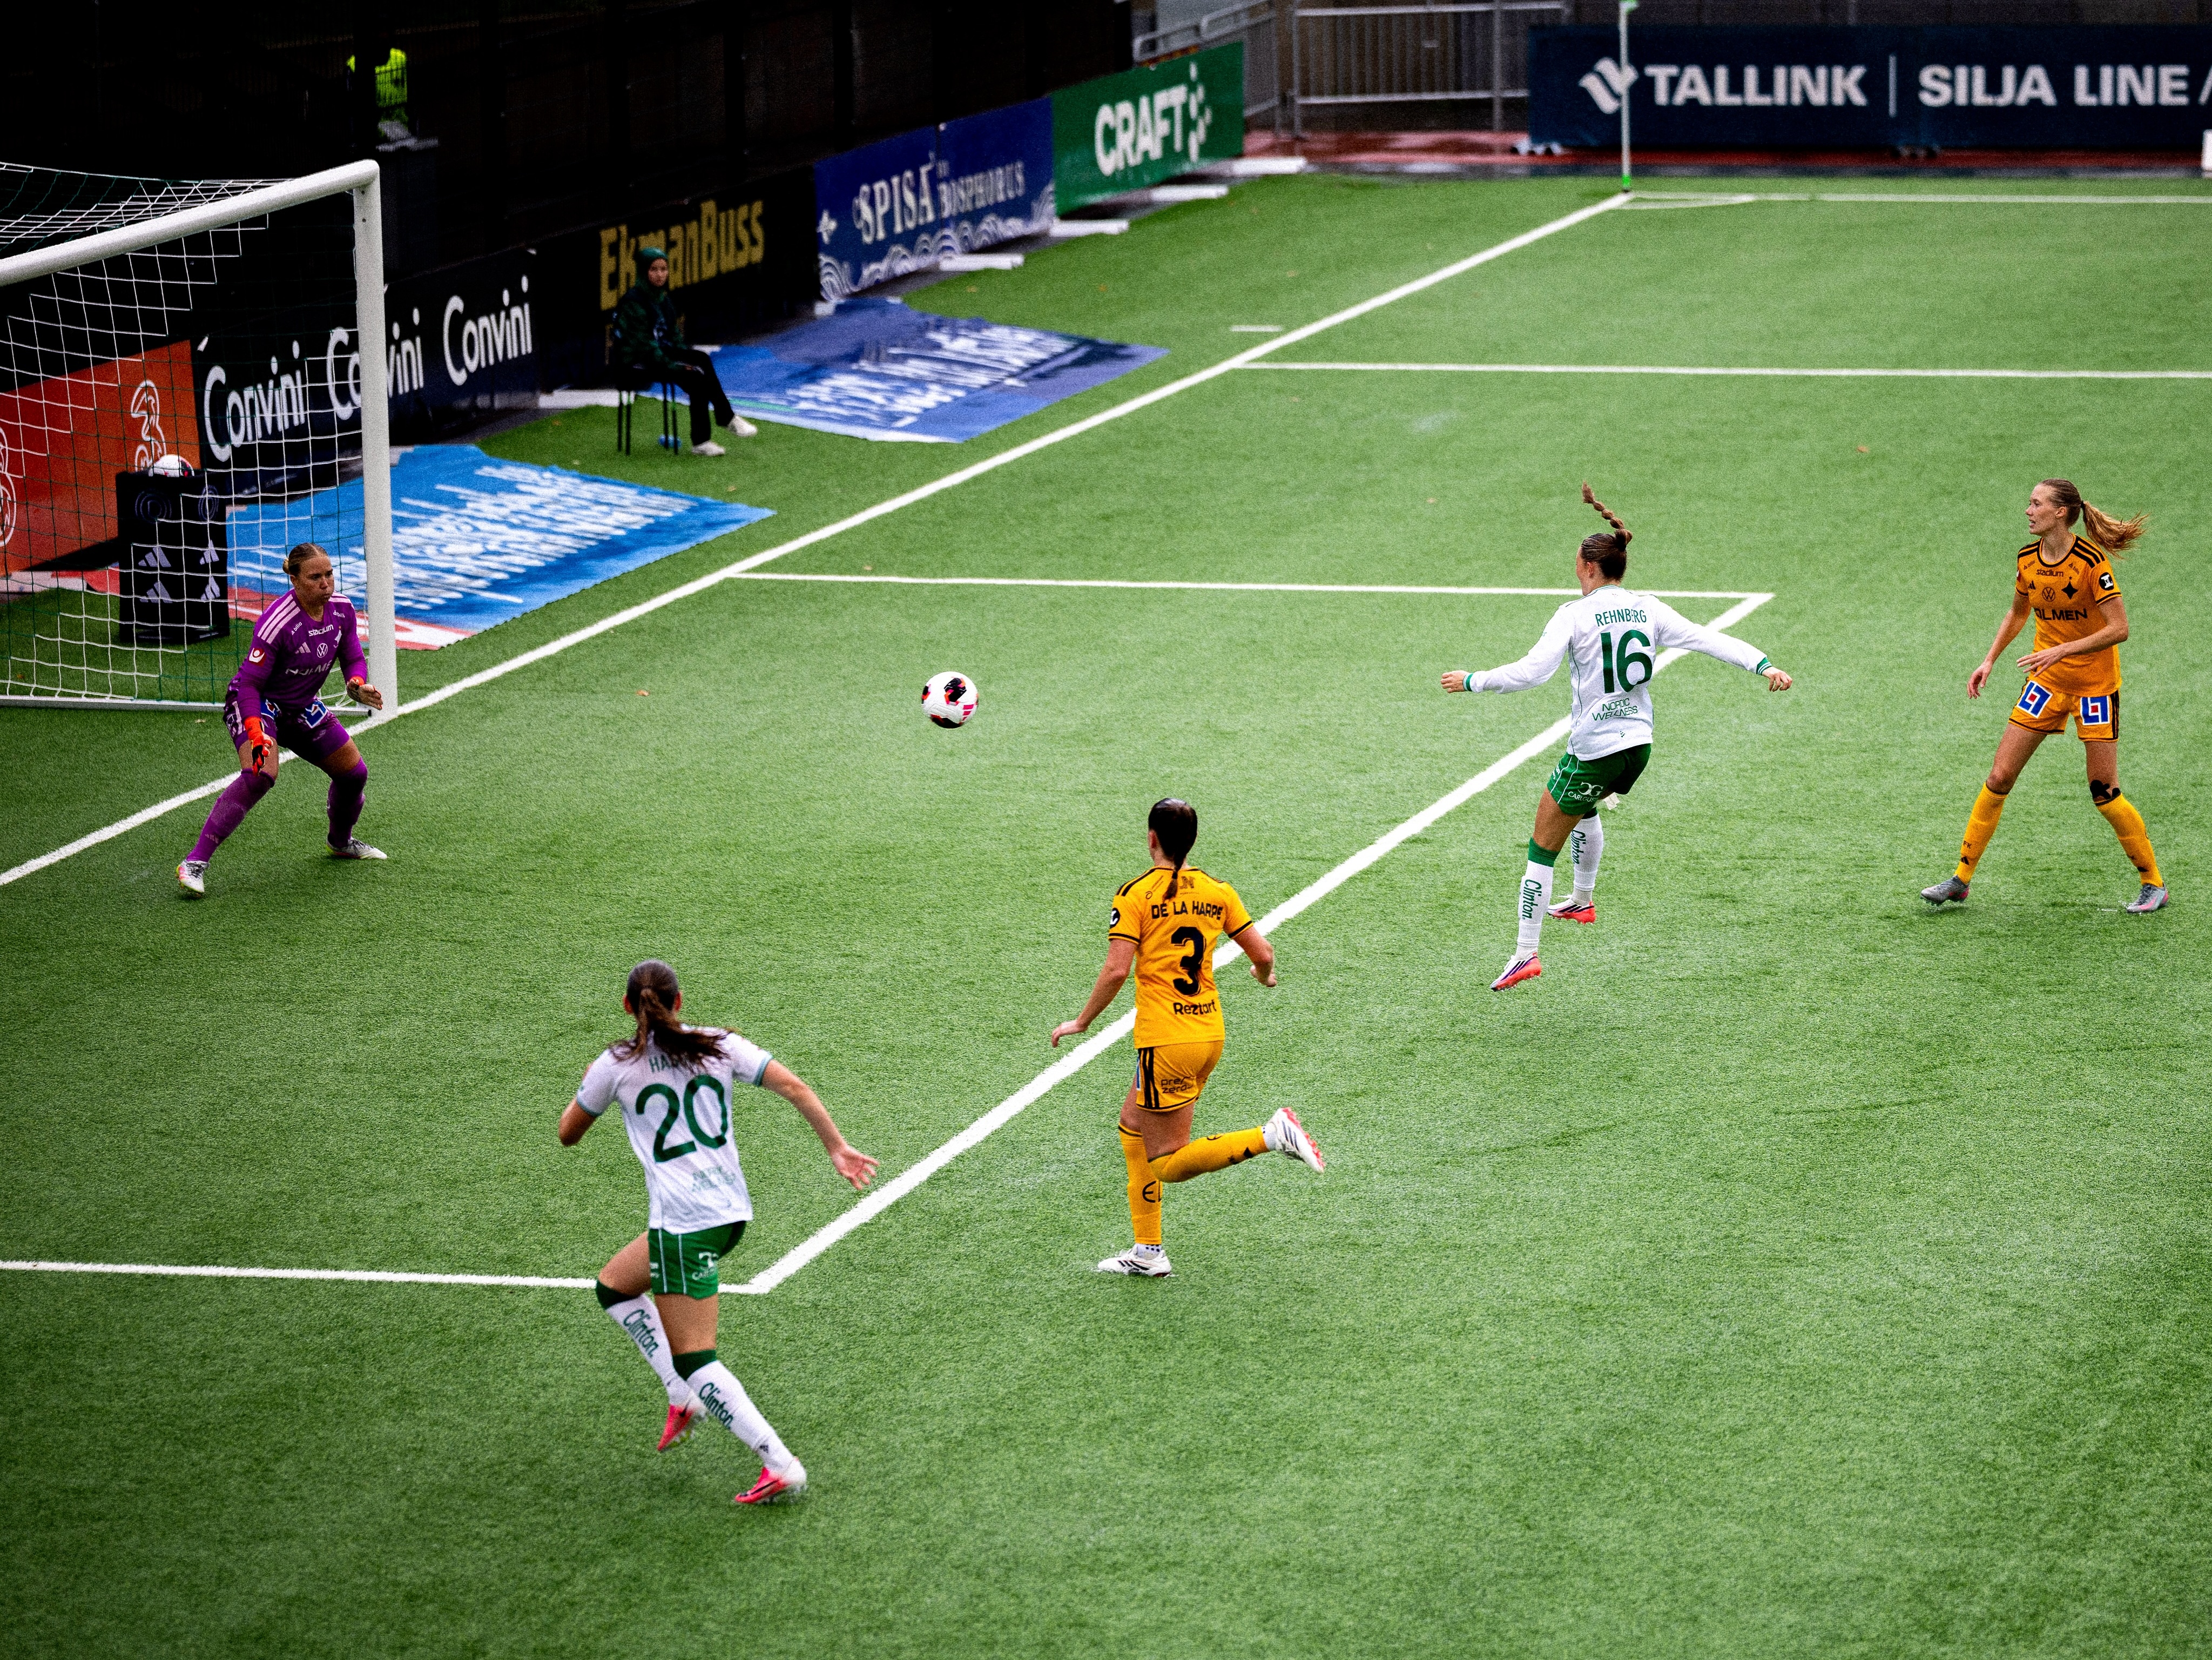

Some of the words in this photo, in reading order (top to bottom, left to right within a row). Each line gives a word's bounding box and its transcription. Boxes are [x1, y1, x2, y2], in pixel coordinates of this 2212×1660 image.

[1644, 64, 1867, 106] TALLINK
[1918, 64, 2058, 107] SILJA
[2074, 64, 2190, 106] LINE
[1095, 84, 1188, 176] CRAFT
[443, 274, 532, 386] Convini
[204, 340, 306, 462] Convini
[2036, 568, 2064, 577] stadium
[1595, 608, 1647, 627] REHNBERG
[1600, 629, 1653, 694] 16
[1602, 697, 1630, 712] NORDIC
[1151, 902, 1168, 919] DE
[1172, 901, 1188, 915] LA
[1191, 900, 1223, 920] HARPE
[1170, 926, 1207, 997] 3
[1172, 999, 1217, 1016] Reztart
[635, 1074, 728, 1163] 20
